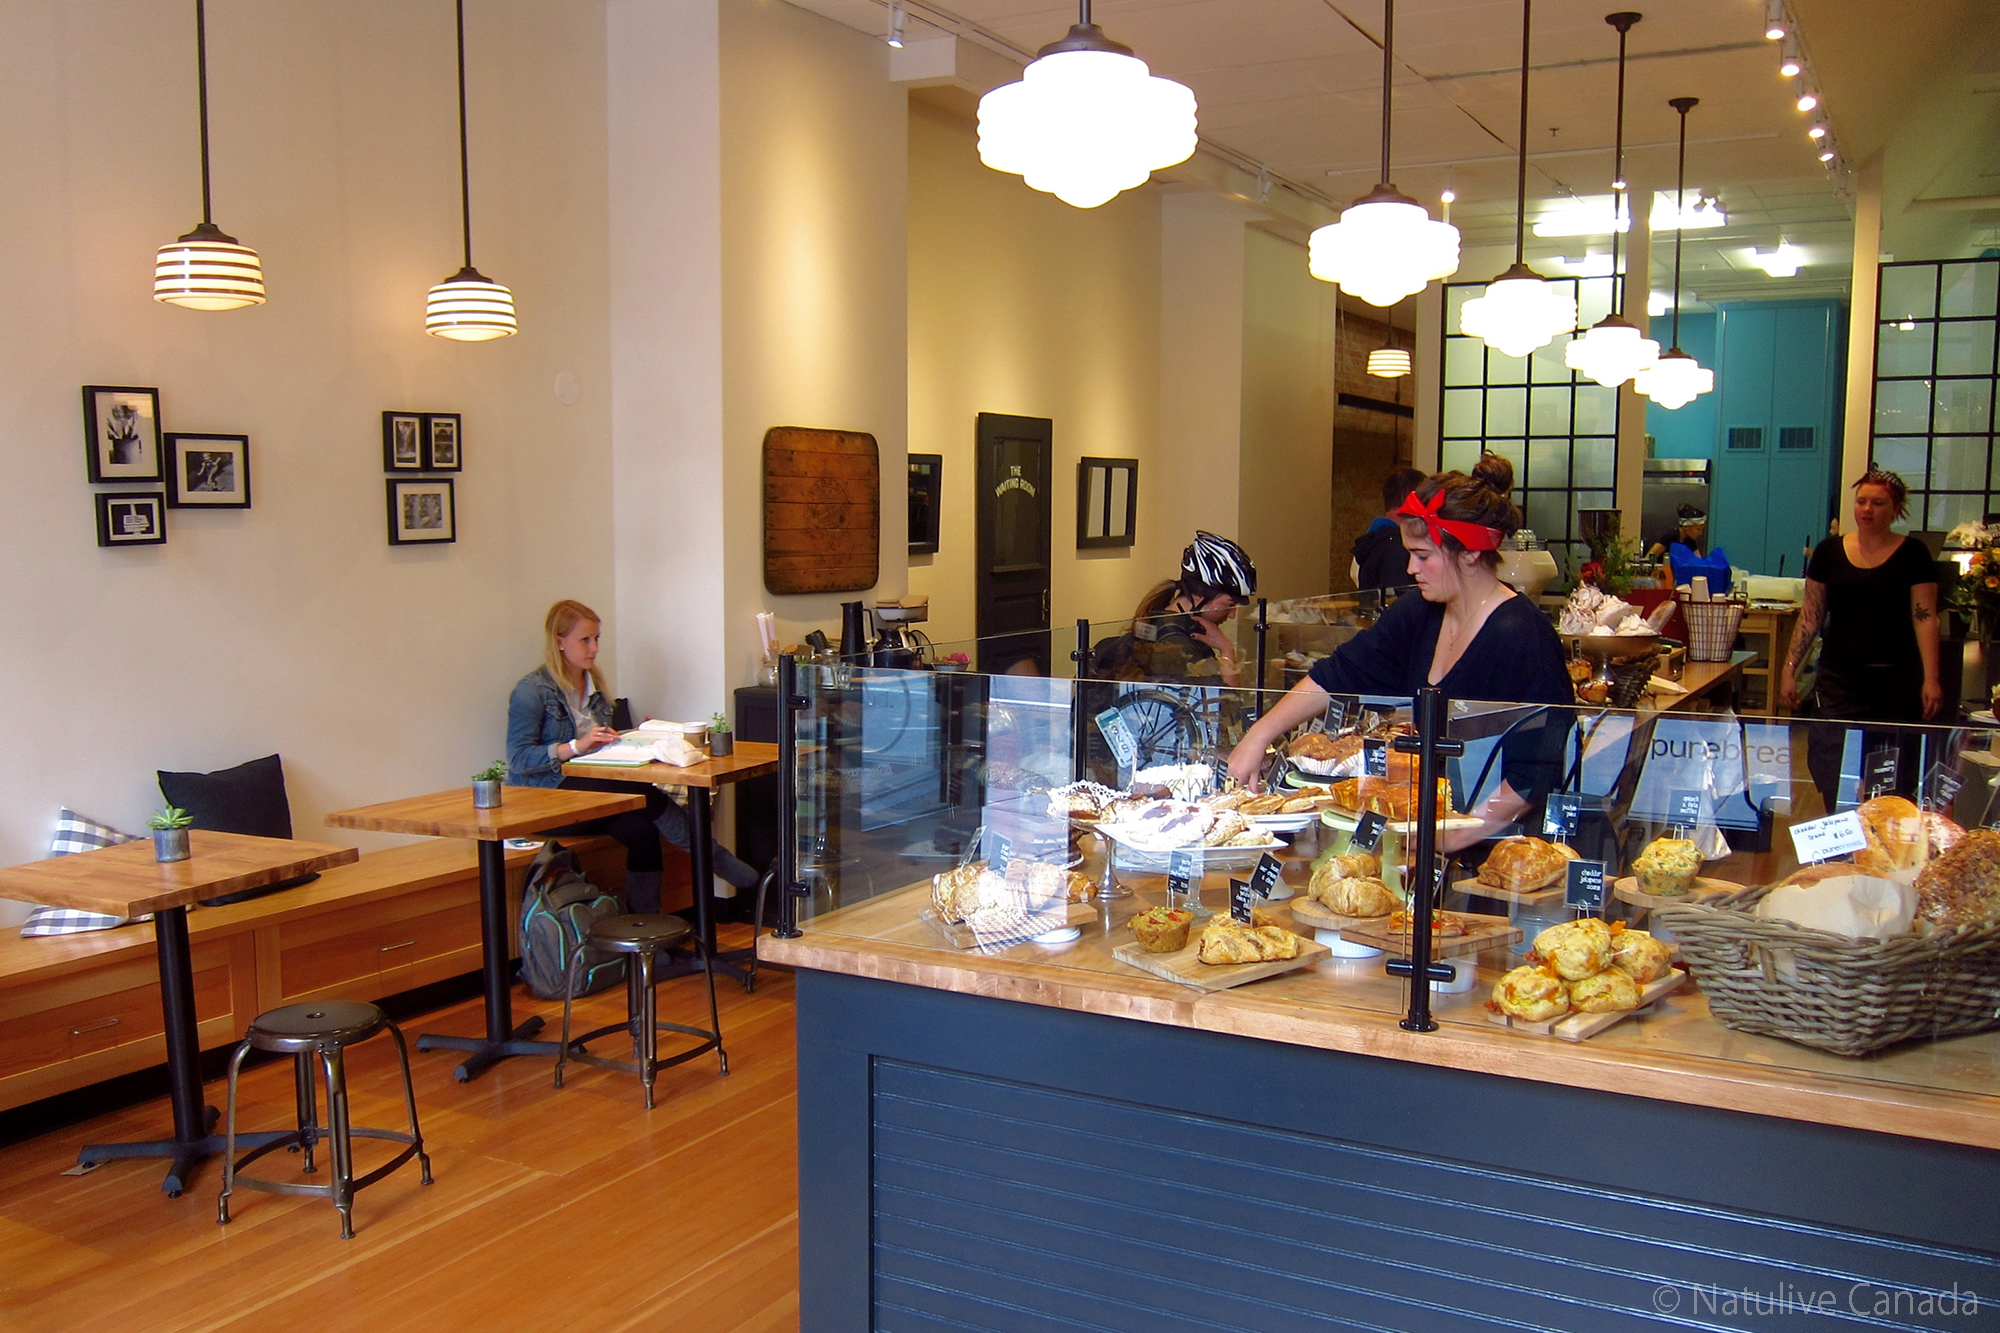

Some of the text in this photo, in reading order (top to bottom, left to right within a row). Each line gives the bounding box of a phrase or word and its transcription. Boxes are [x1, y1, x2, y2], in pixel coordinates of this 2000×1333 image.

[1010, 465, 1022, 477] THE
[994, 477, 1036, 498] WAITING ROOM
[1580, 869, 1602, 877] cheddar
